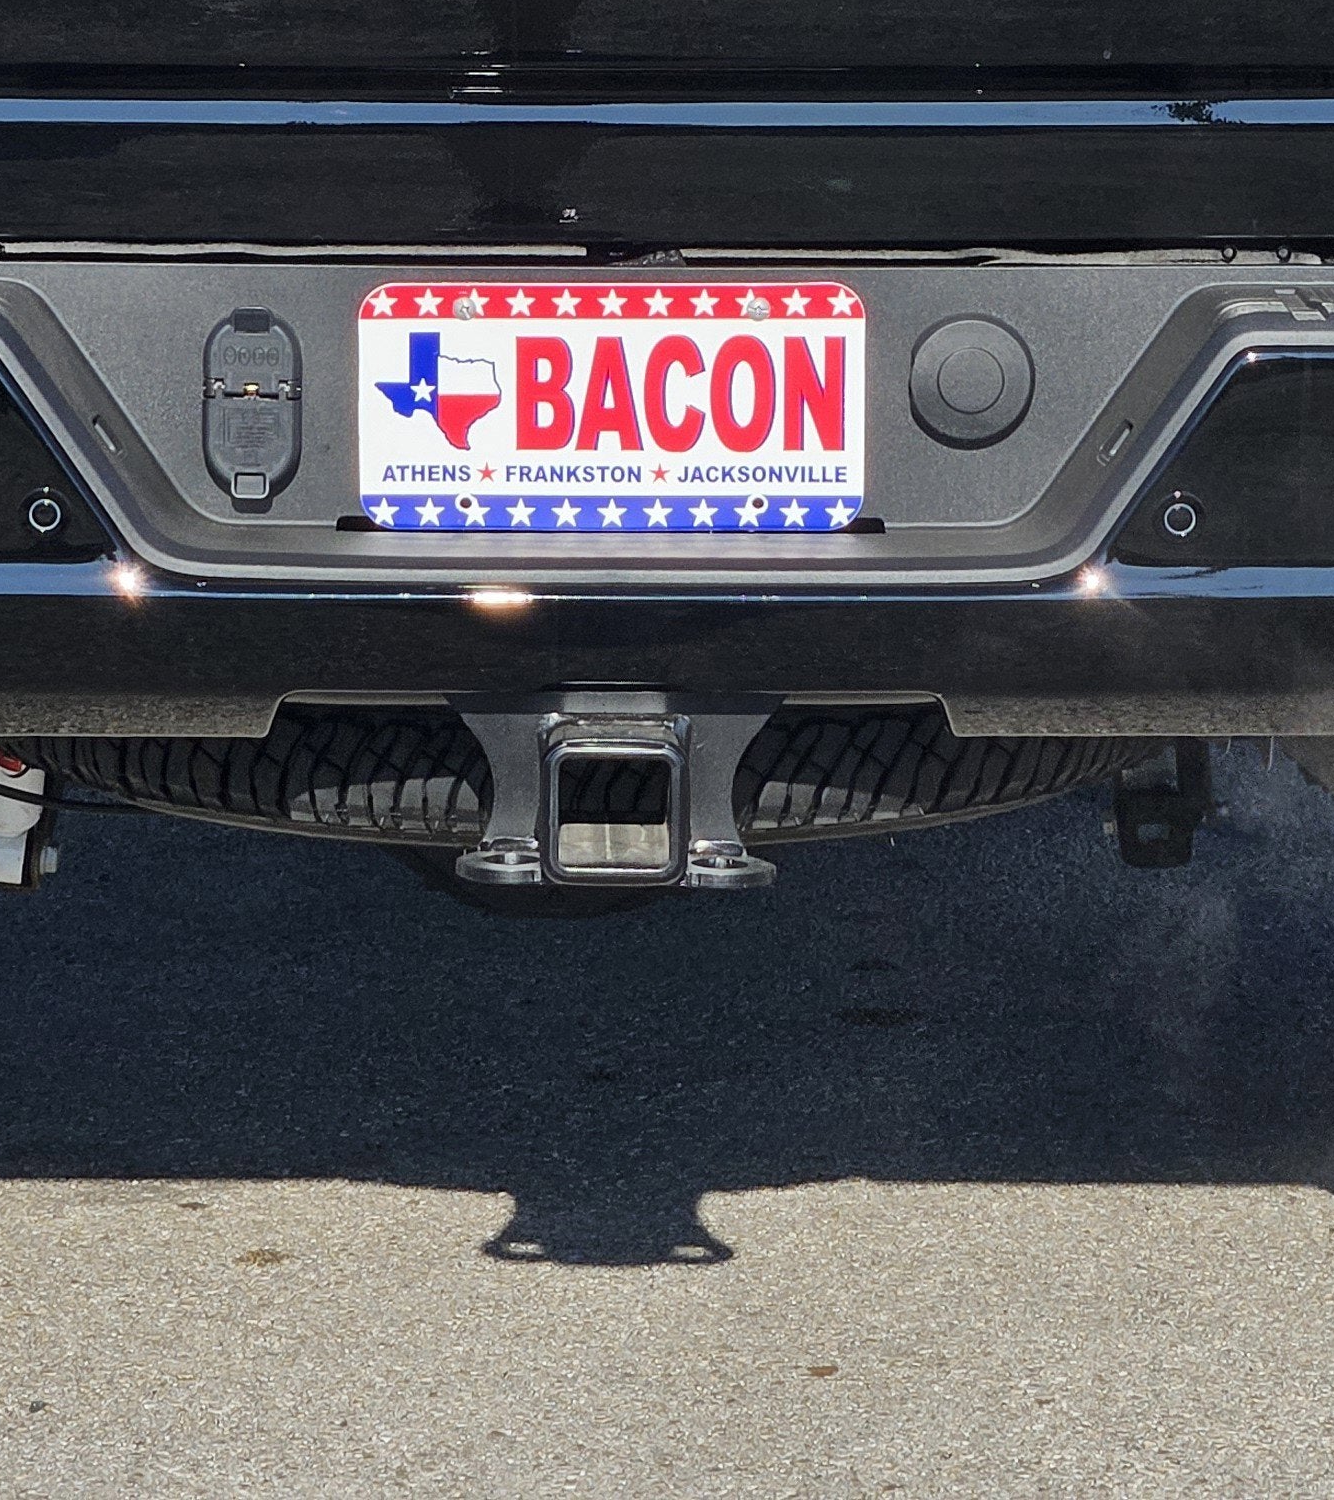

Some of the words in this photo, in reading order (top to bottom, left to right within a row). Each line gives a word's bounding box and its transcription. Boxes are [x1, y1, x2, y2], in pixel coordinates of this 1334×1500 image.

[515, 334, 847, 453] BACON
[381, 463, 472, 484] ATHENS
[504, 463, 643, 484] FRANKSTON
[676, 463, 848, 485] JACKSONVILLE
